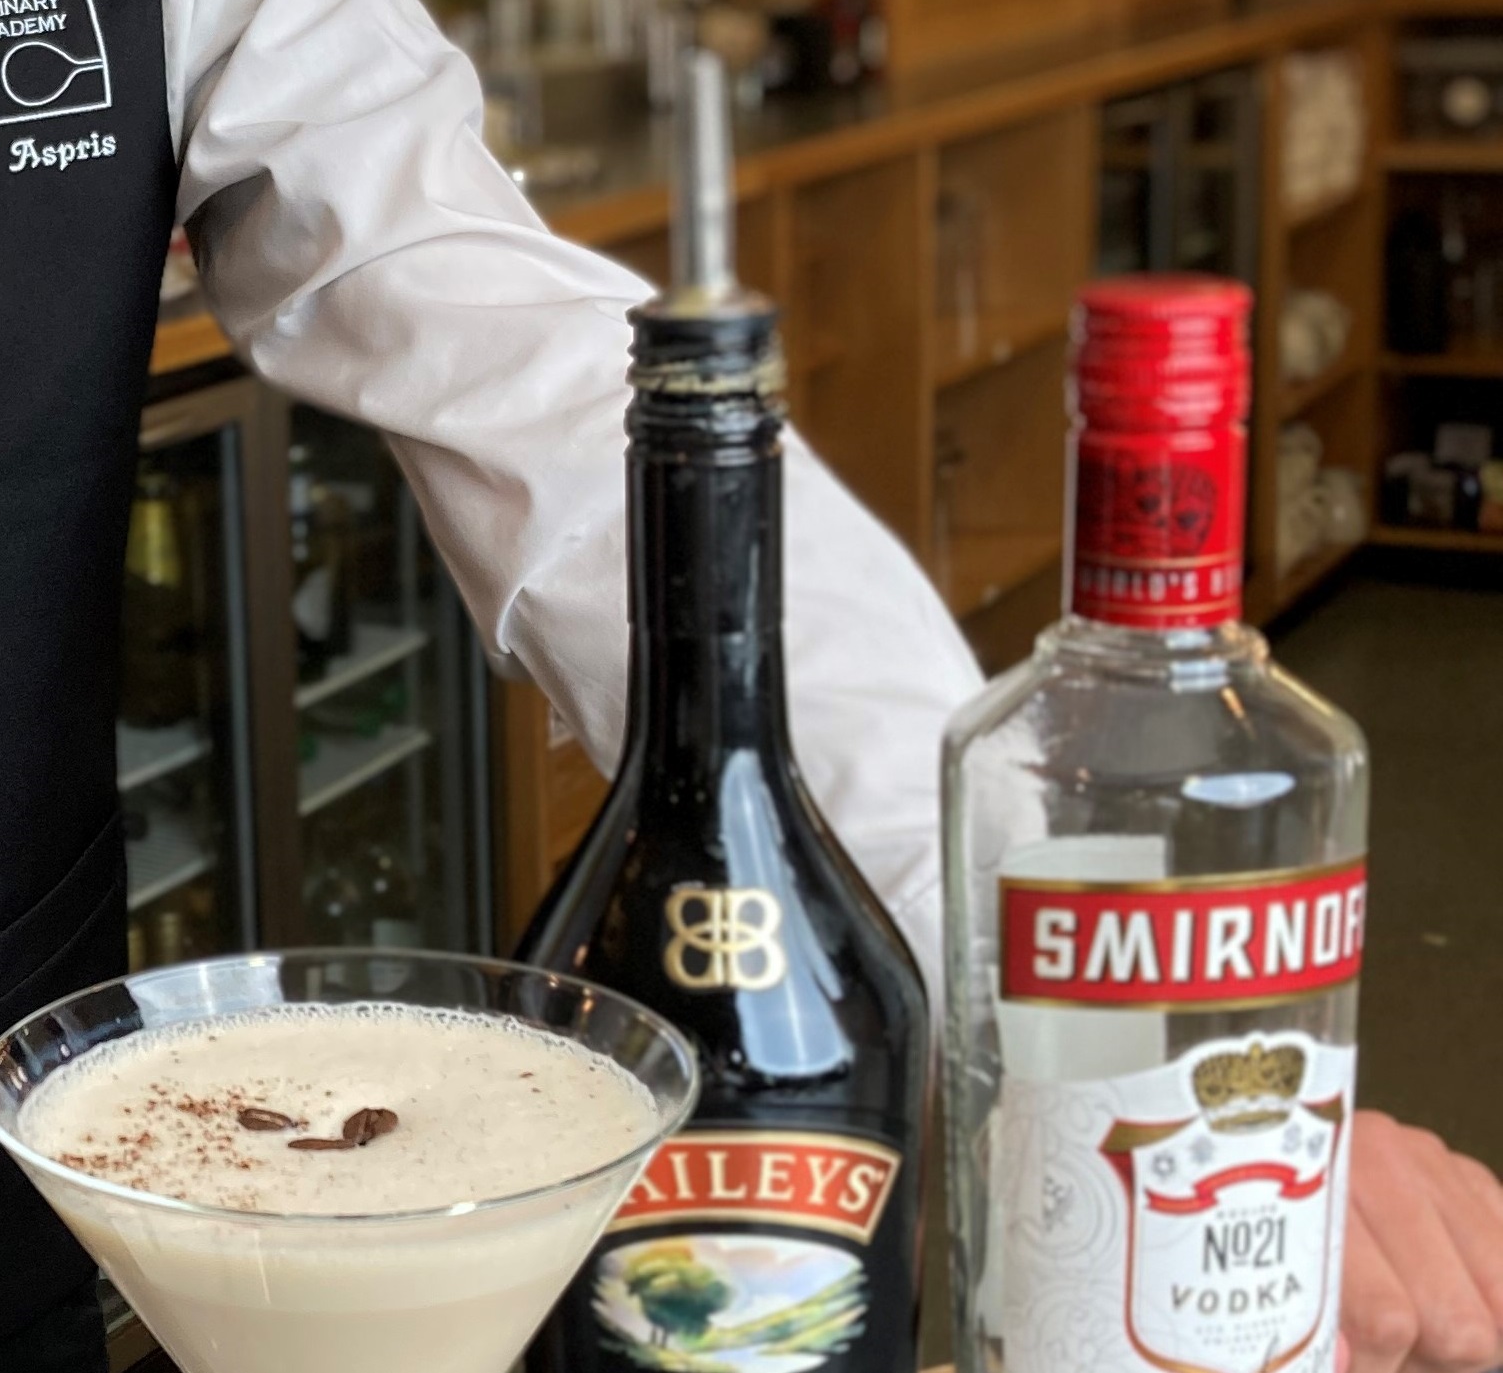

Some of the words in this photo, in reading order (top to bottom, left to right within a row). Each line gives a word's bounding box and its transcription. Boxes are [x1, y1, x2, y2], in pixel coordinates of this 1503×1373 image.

[8, 130, 117, 173] Aspris
[1033, 881, 1367, 983] SMIRNOF
[626, 1151, 878, 1213] AILEYS
[1170, 1272, 1302, 1315] VODKA
